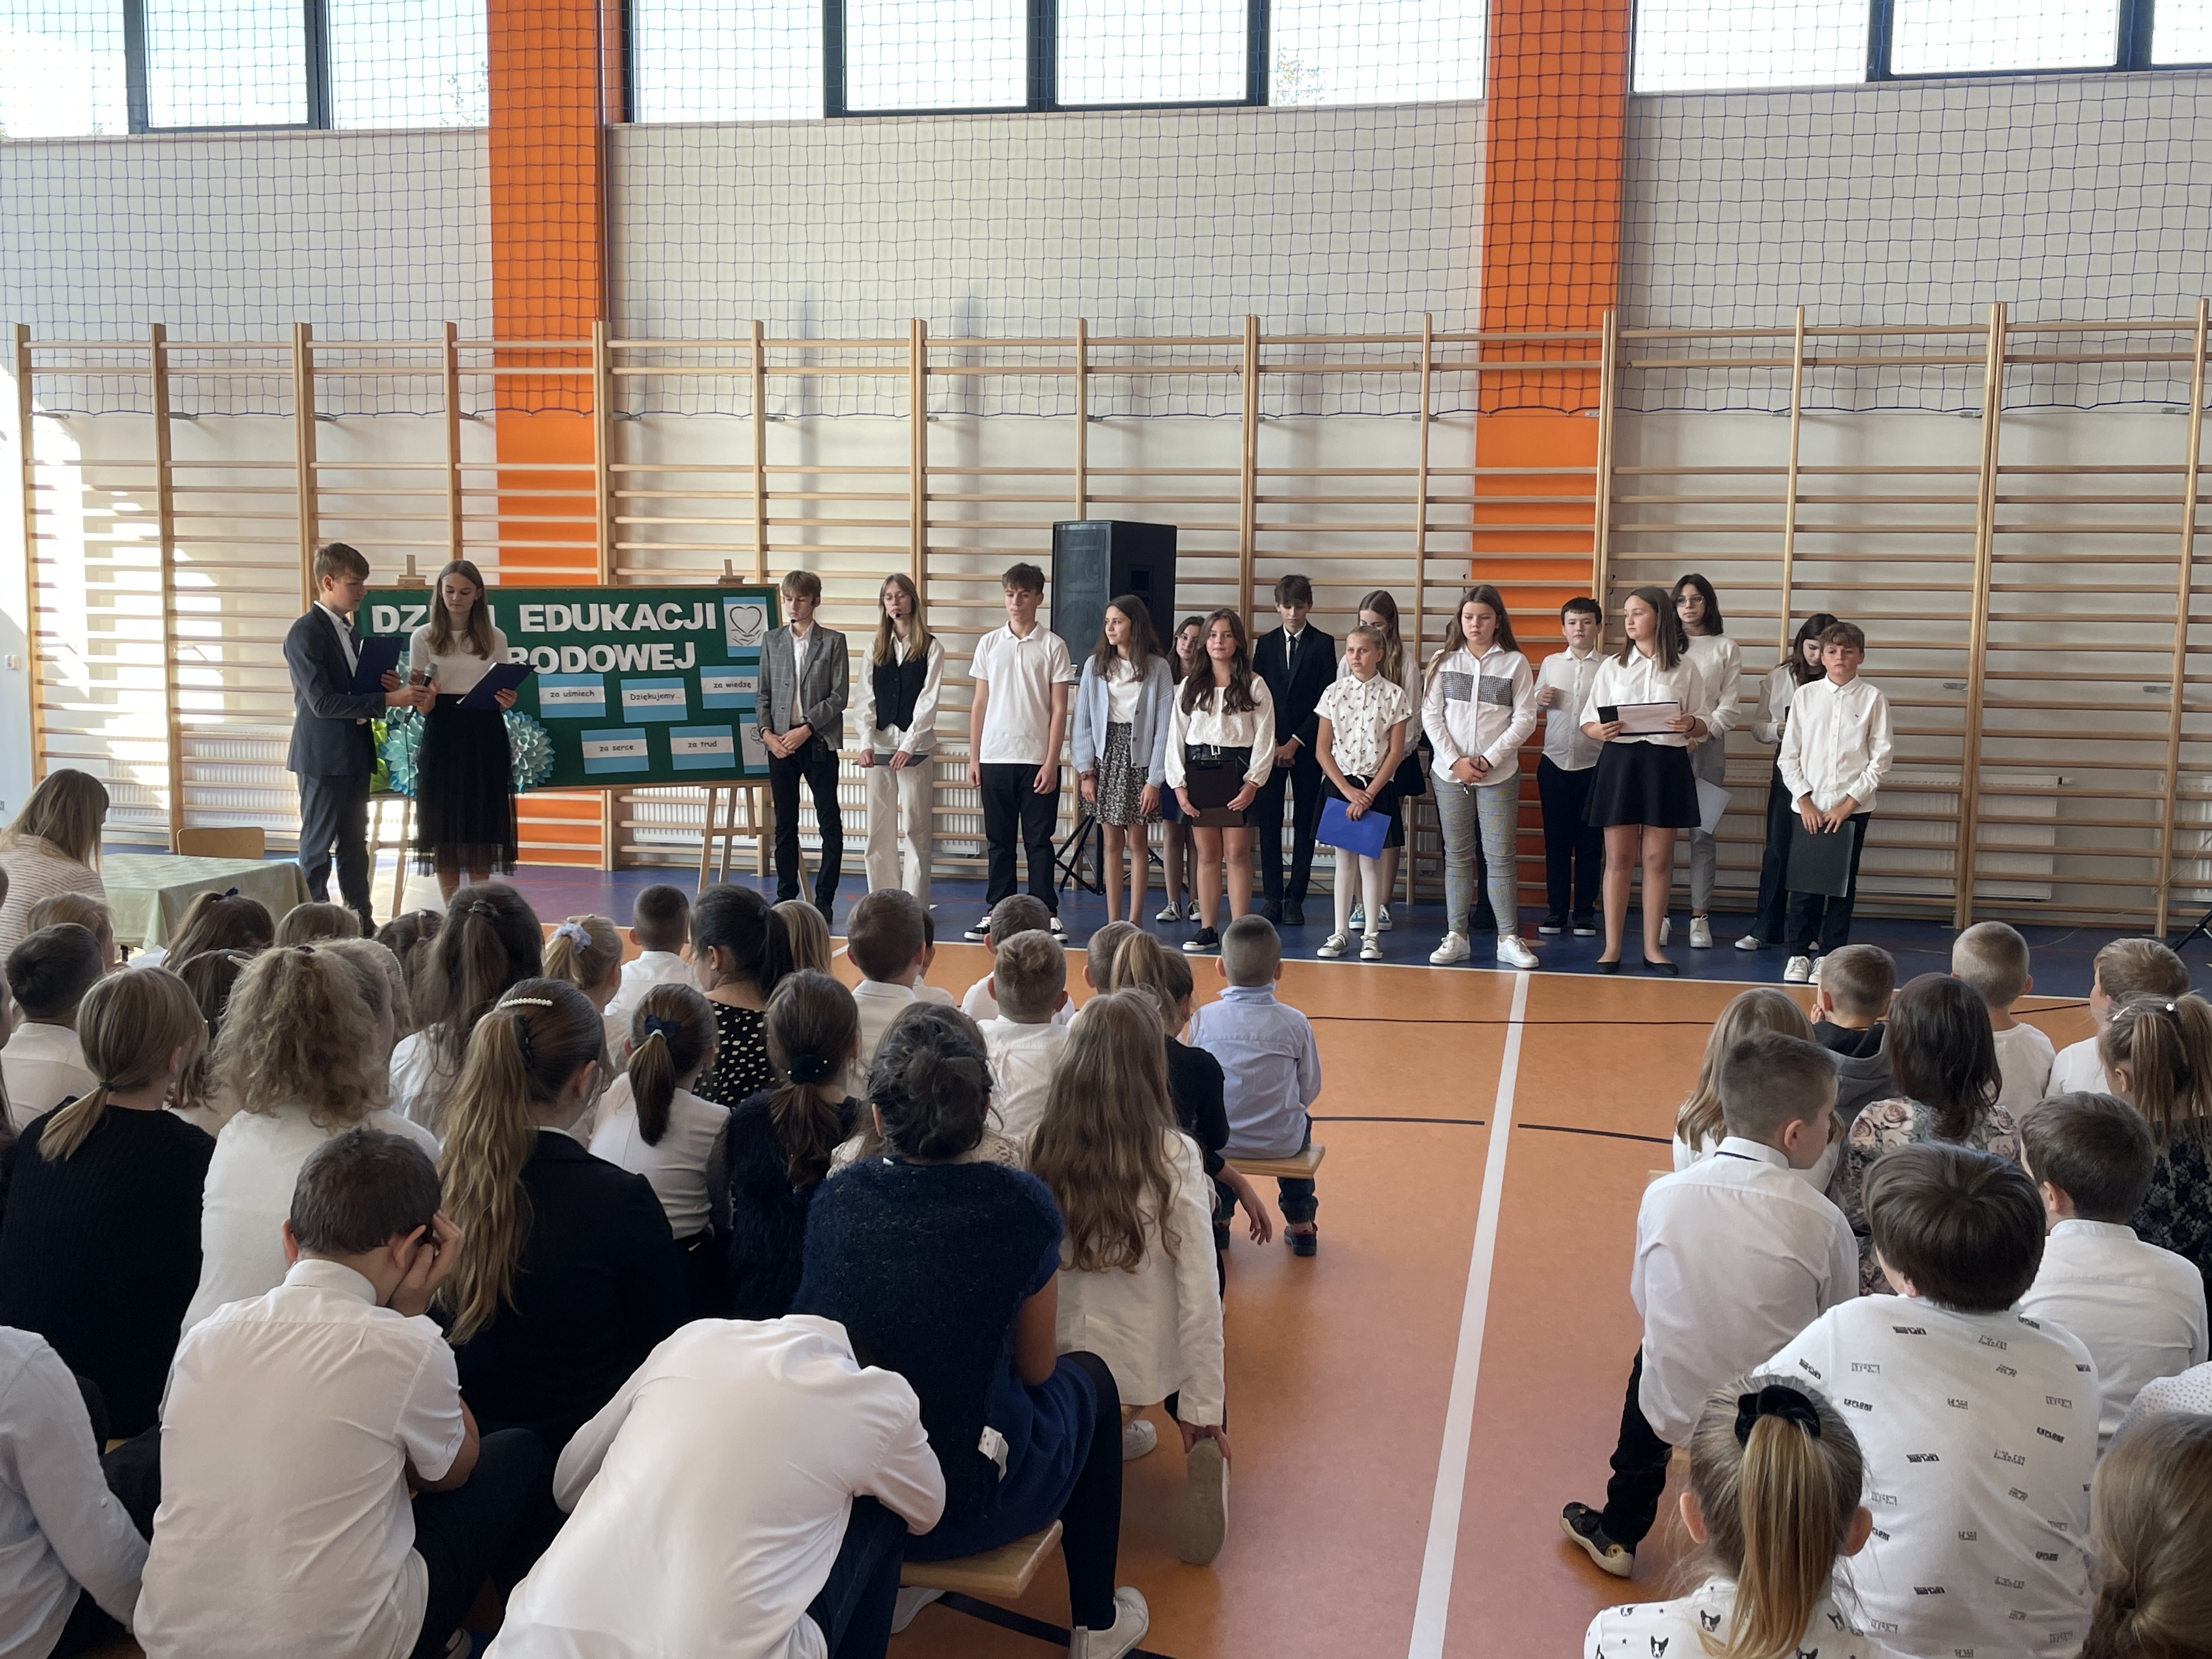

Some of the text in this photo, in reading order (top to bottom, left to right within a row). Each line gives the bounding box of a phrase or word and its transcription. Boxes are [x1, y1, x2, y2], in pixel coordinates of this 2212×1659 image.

[519, 602, 716, 633] EDUKACJI
[507, 642, 695, 674] RODOWEJ
[725, 680, 752, 689] wiedzę
